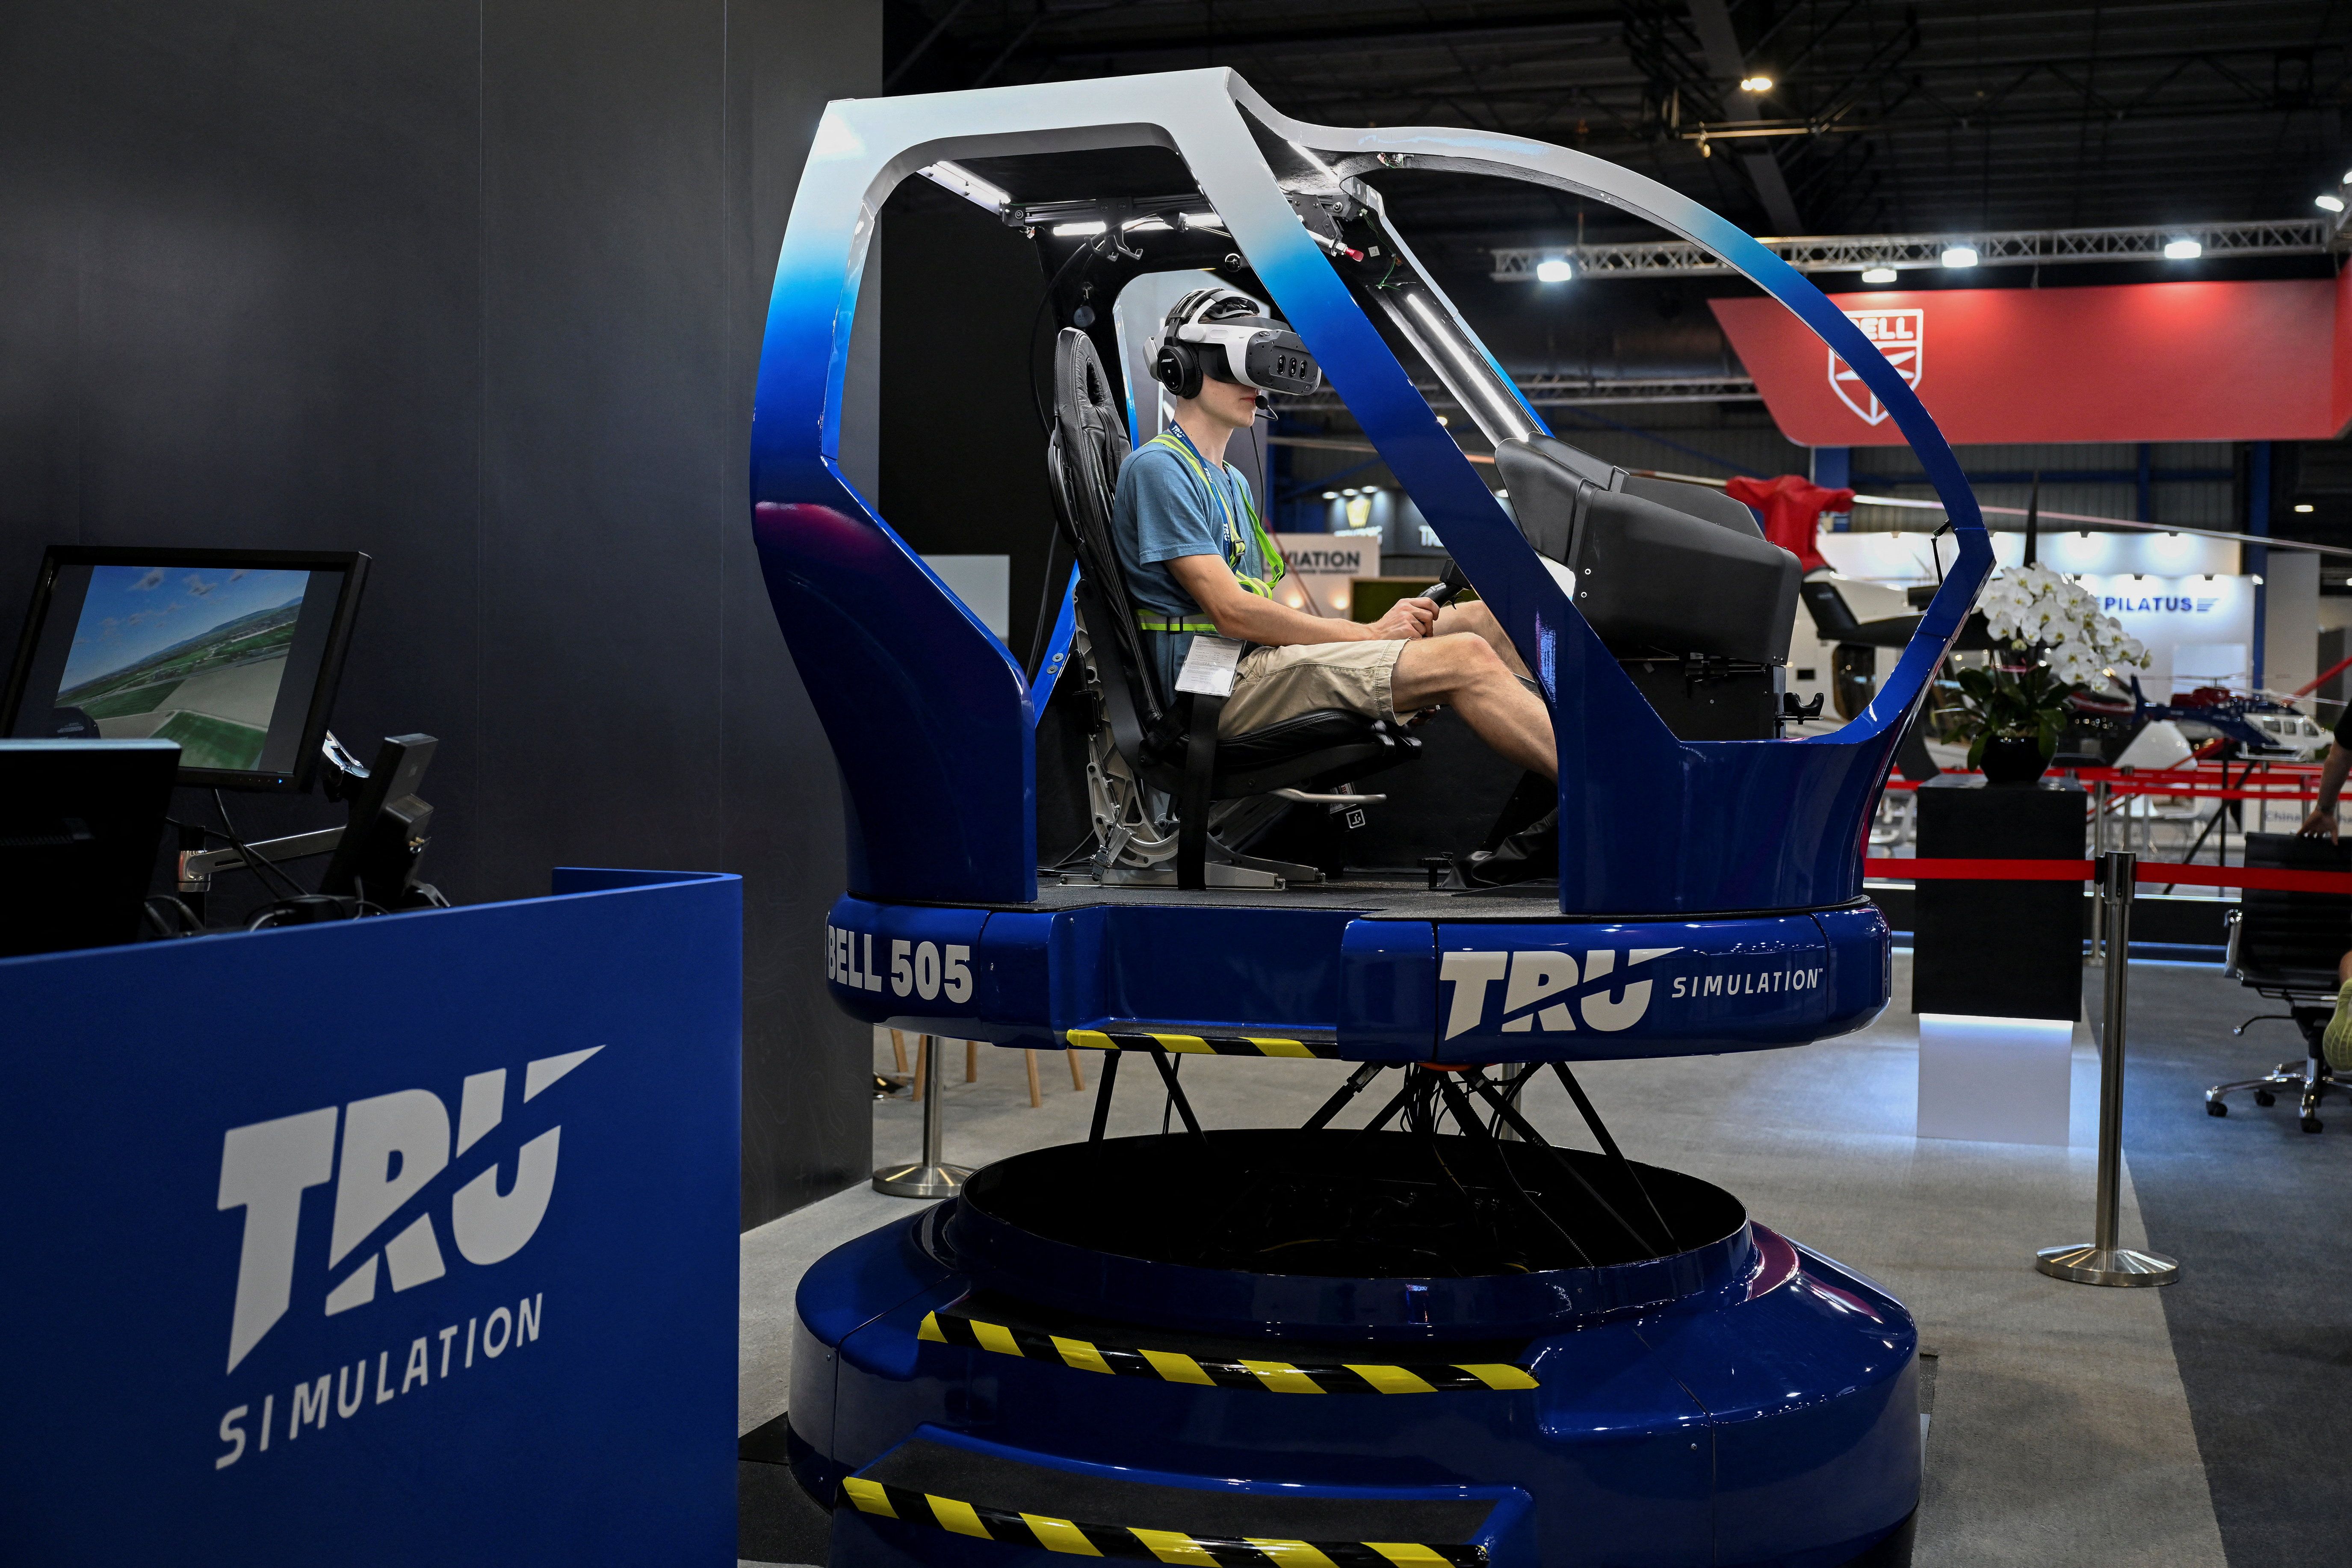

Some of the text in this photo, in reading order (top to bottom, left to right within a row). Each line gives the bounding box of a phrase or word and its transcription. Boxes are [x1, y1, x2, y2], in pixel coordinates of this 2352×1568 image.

[1850, 316, 1914, 340] ELL
[1171, 425, 1186, 438] TRU
[1278, 550, 1361, 567] VIATION
[2105, 597, 2192, 611] PILATUS
[828, 924, 972, 1003] BELL 505
[1439, 946, 1685, 1041] TRU
[217, 1044, 606, 1374] TRU
[216, 1293, 543, 1470] SIMULATION
